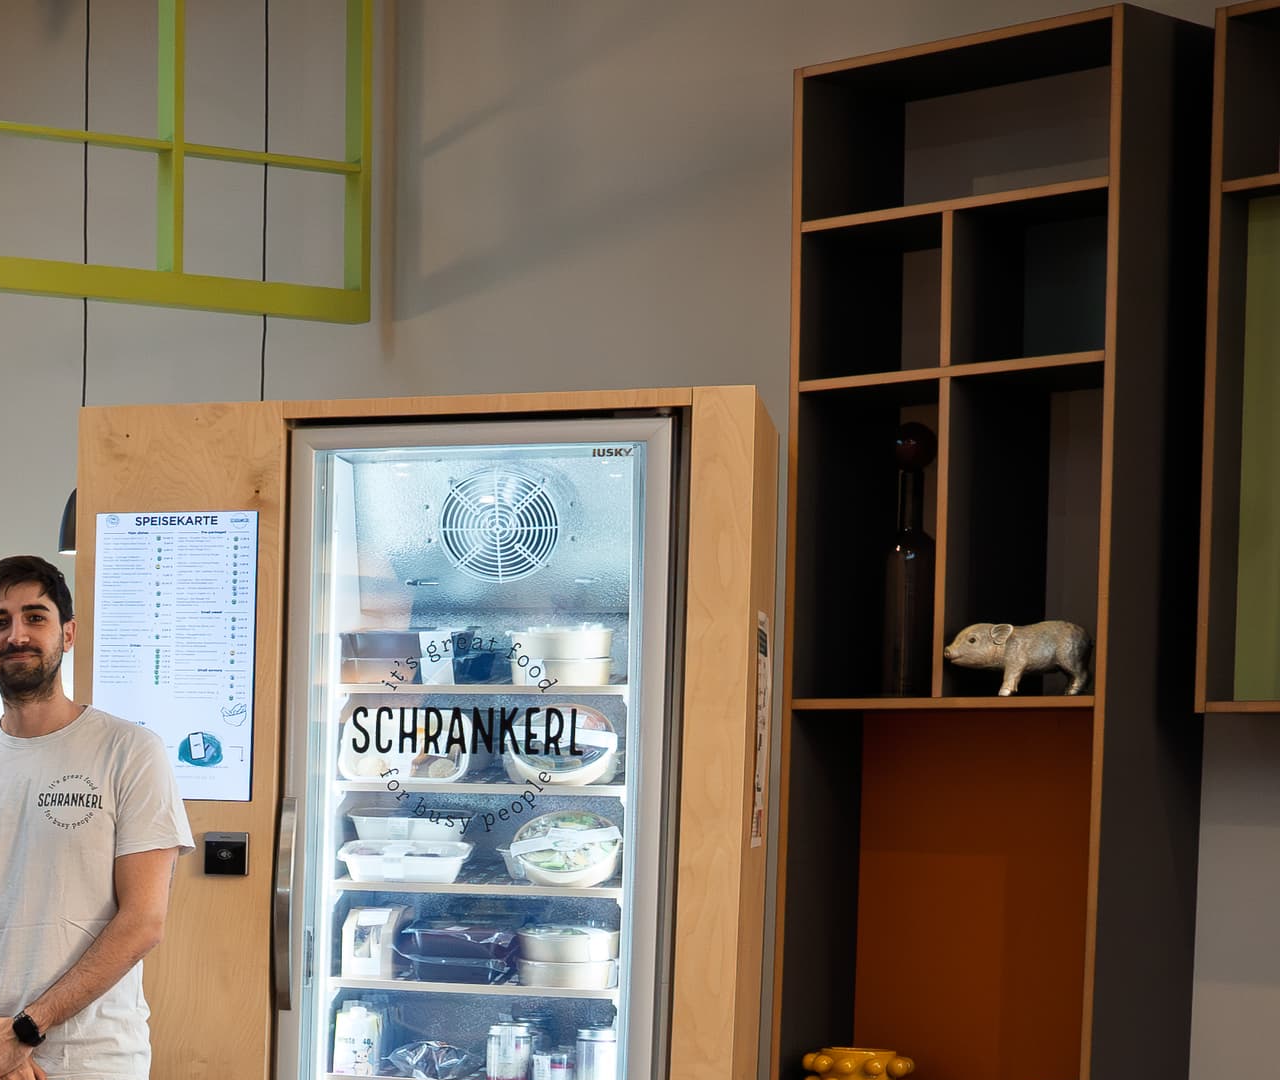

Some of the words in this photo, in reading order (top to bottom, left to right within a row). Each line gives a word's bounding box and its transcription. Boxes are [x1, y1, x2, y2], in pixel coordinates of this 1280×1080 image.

[135, 516, 218, 526] SPEISEKARTE
[427, 637, 497, 662] great
[506, 643, 558, 693] food
[352, 706, 583, 755] SCHRANKERL
[38, 793, 103, 809] SCHRANKERL
[380, 768, 409, 802] for
[413, 797, 471, 834] busy
[482, 771, 551, 832] people
